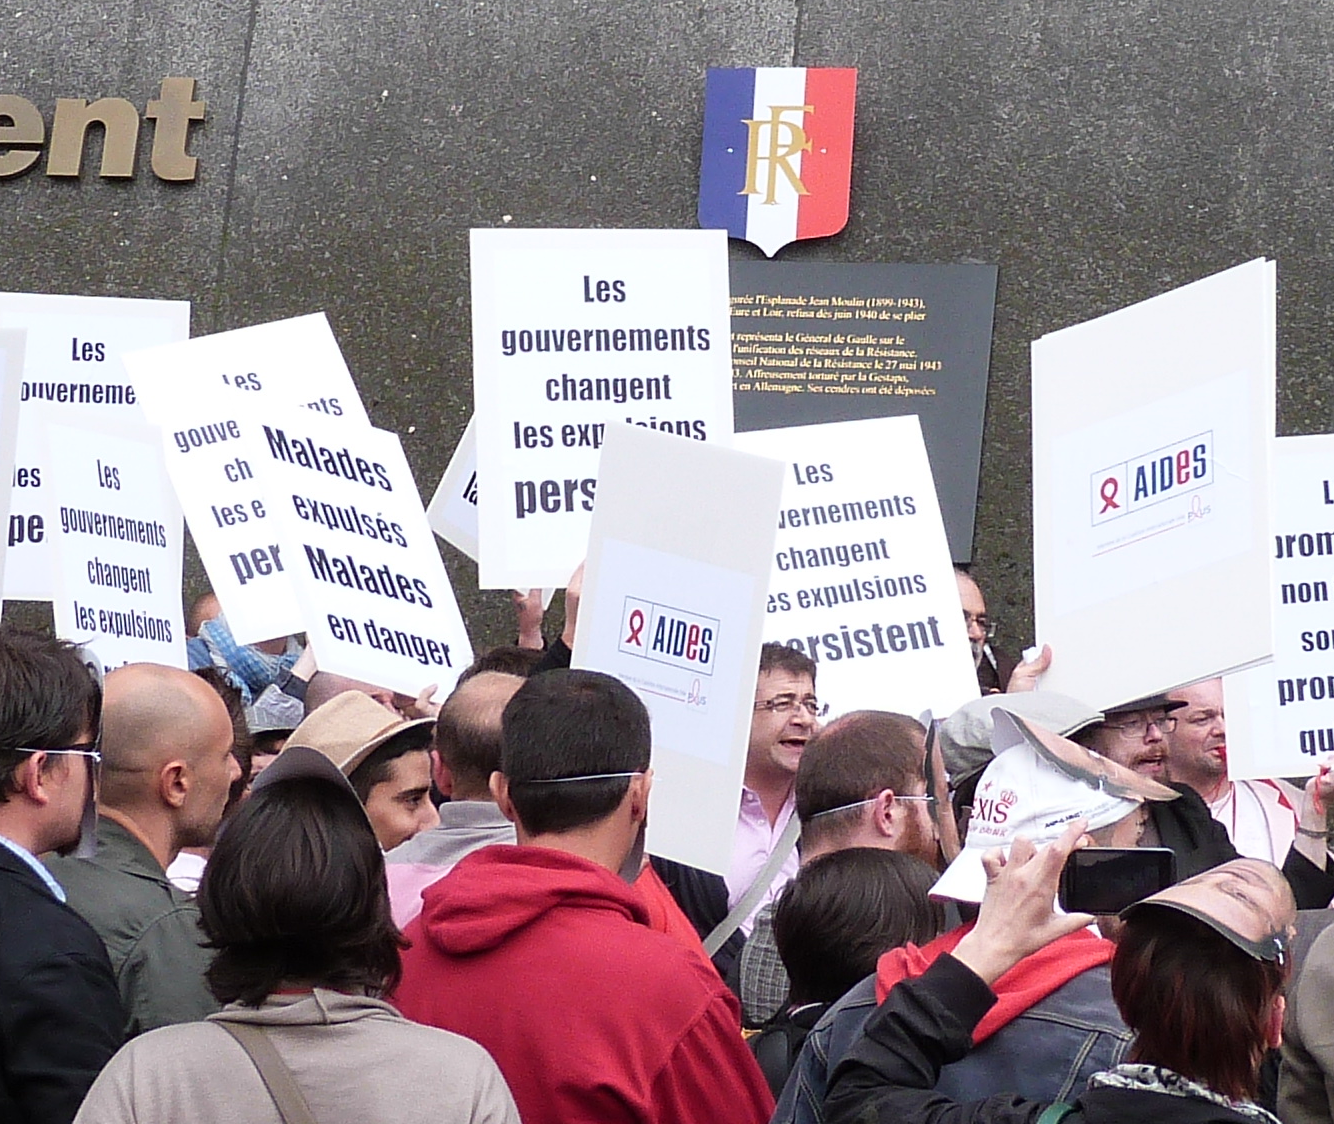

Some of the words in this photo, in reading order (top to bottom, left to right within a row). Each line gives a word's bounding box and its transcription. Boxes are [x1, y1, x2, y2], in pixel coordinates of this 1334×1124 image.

[583, 275, 626, 303] Les
[808, 296, 829, 306] Jean
[831, 297, 864, 306] Moulin
[878, 310, 890, 320] de
[72, 338, 105, 362] Les
[502, 325, 710, 357] gouvernements
[785, 332, 794, 343] le
[833, 334, 845, 344] de
[847, 334, 877, 345] Gaulle
[895, 335, 905, 345] le
[842, 346, 854, 356] de
[855, 346, 865, 356] la
[758, 357, 798, 367] National
[799, 358, 812, 368] de
[813, 358, 822, 368] la
[874, 359, 884, 370] le
[885, 360, 898, 370] 27
[857, 372, 867, 381] la
[21, 381, 137, 405] ouverneme
[545, 374, 672, 403] changent
[514, 421, 553, 449] les
[263, 425, 393, 492] Malades
[97, 459, 121, 491] Les
[793, 463, 833, 485] Les
[60, 506, 167, 548] gouvernements
[211, 502, 248, 527] les
[292, 494, 408, 548] expulsés
[776, 539, 890, 570] changent
[87, 556, 152, 594] changent
[303, 544, 434, 608] Malades
[767, 592, 791, 613] es
[797, 575, 927, 608] expulsions
[1282, 580, 1328, 604] non
[75, 601, 96, 632] les
[99, 607, 173, 644] expulsions
[328, 613, 361, 645] en
[364, 619, 453, 668] danger
[762, 616, 944, 663] ersistent
